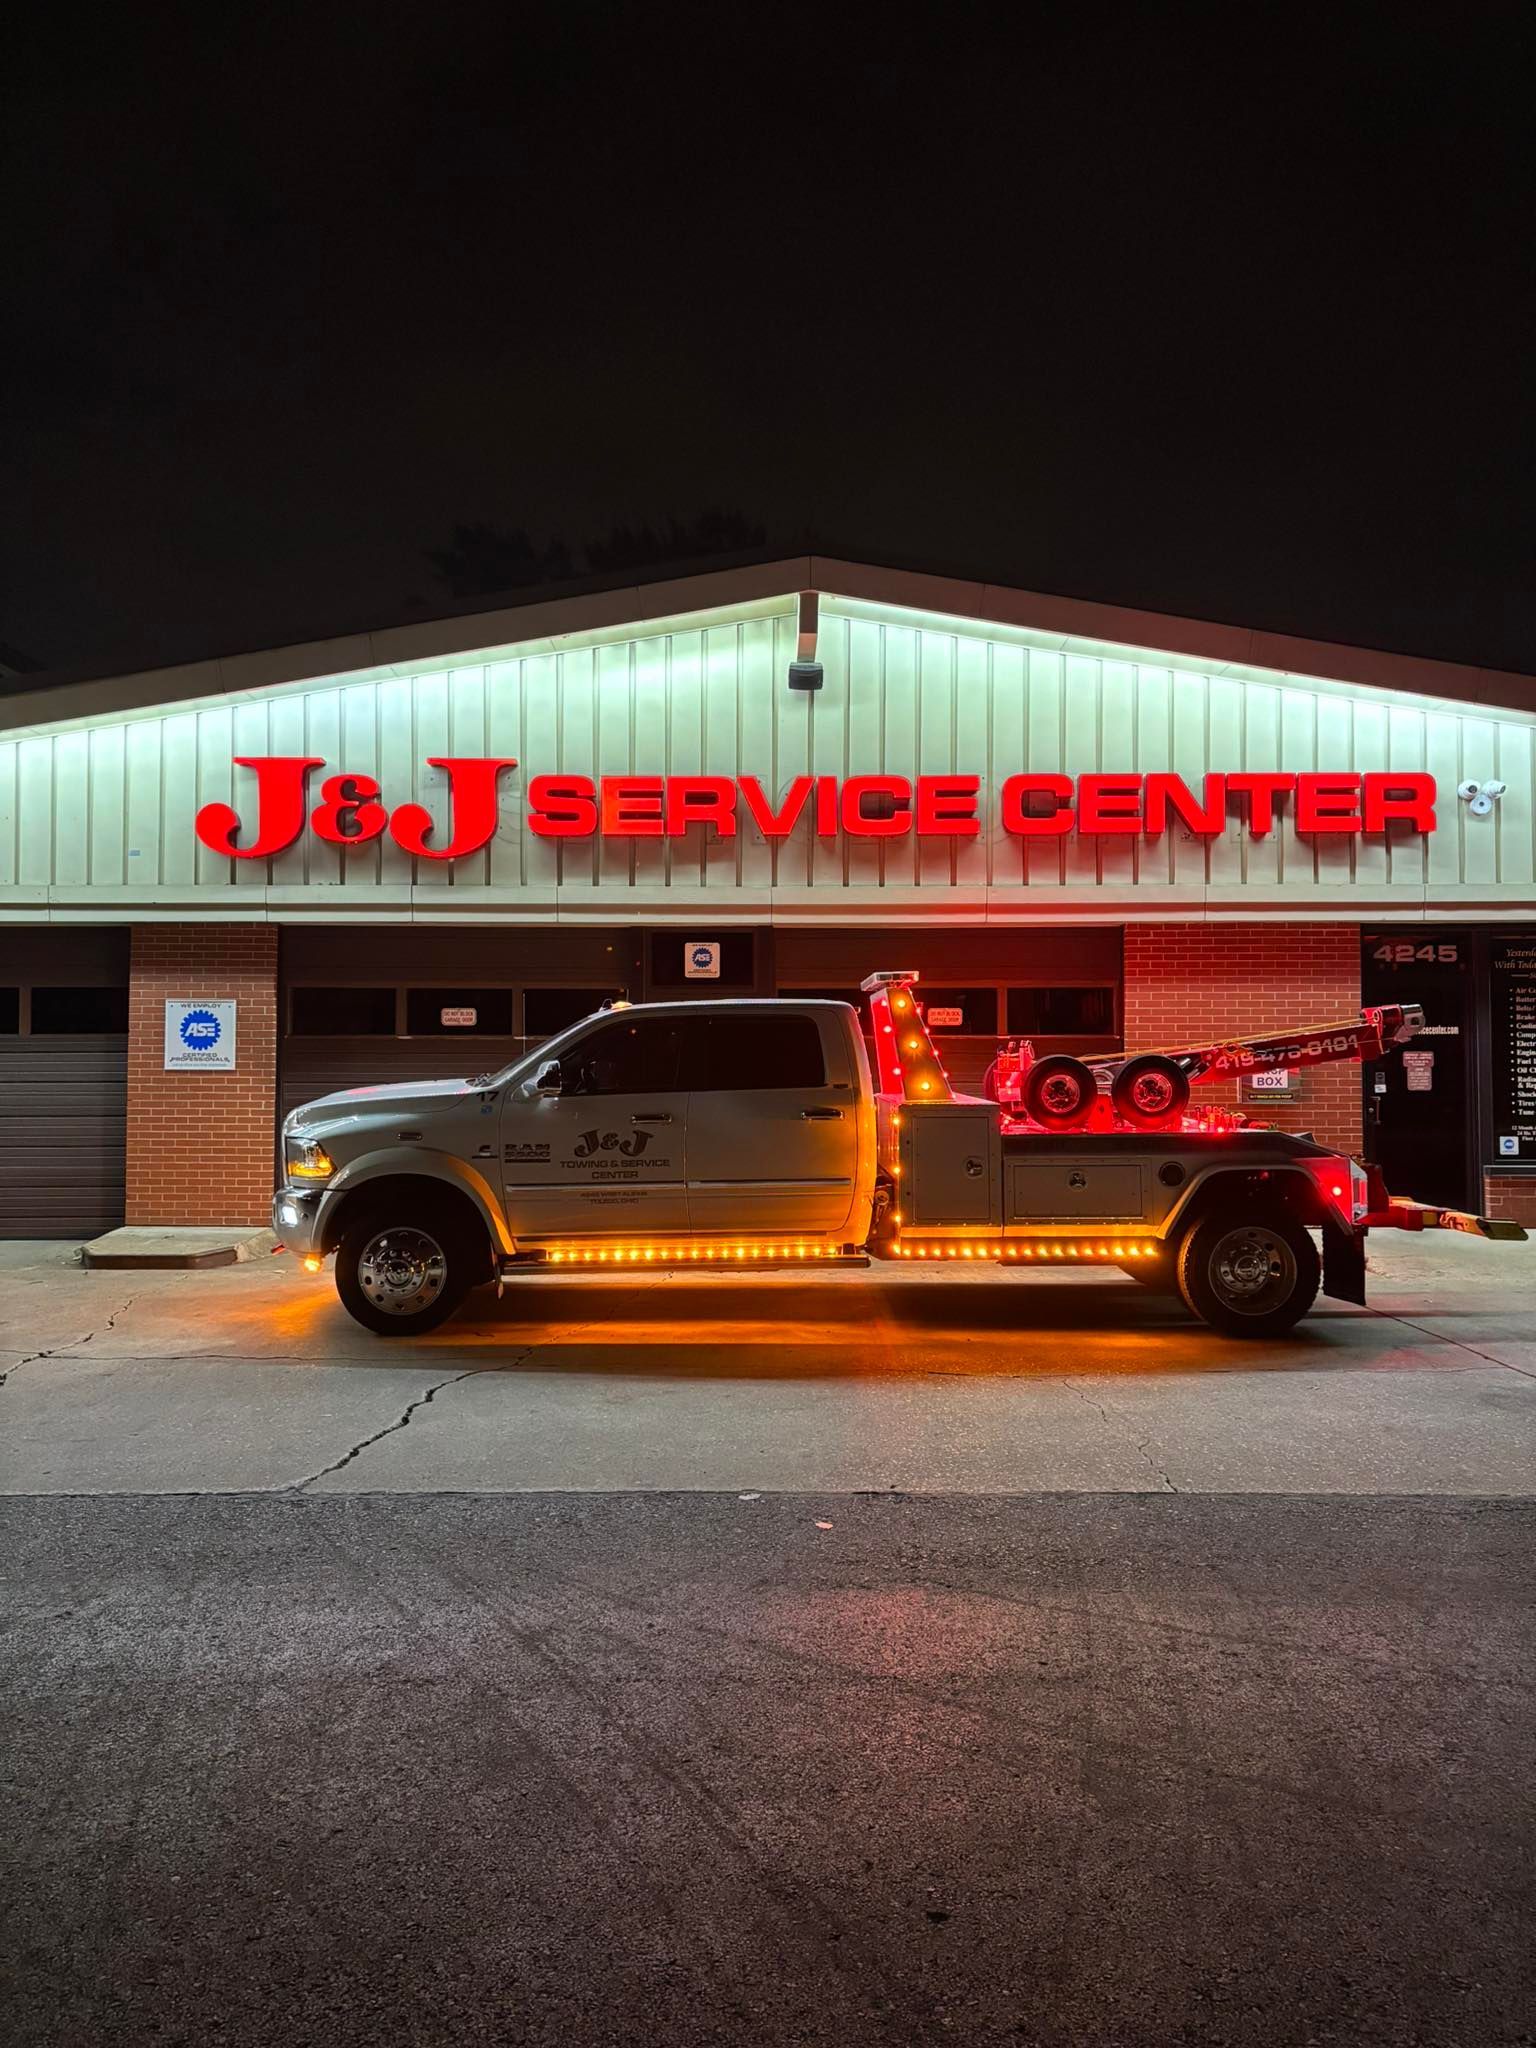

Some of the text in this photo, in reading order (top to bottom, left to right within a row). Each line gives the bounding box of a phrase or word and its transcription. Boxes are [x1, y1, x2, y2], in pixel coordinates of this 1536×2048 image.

[195, 757, 1437, 859] J&J SERVICE CENTER
[695, 953, 710, 962] ASE
[1373, 945, 1458, 962] 4245
[1494, 960, 1516, 969] With
[184, 1022, 216, 1037] ASE
[1517, 1066, 1528, 1074] Oil
[1257, 1077, 1282, 1086] BOX
[476, 1091, 499, 1101] 17
[574, 1128, 655, 1158] J&J
[560, 1160, 608, 1169] TOWING
[611, 1160, 618, 1168] &
[621, 1159, 670, 1168] SERVICE
[592, 1171, 639, 1179] CENTER
